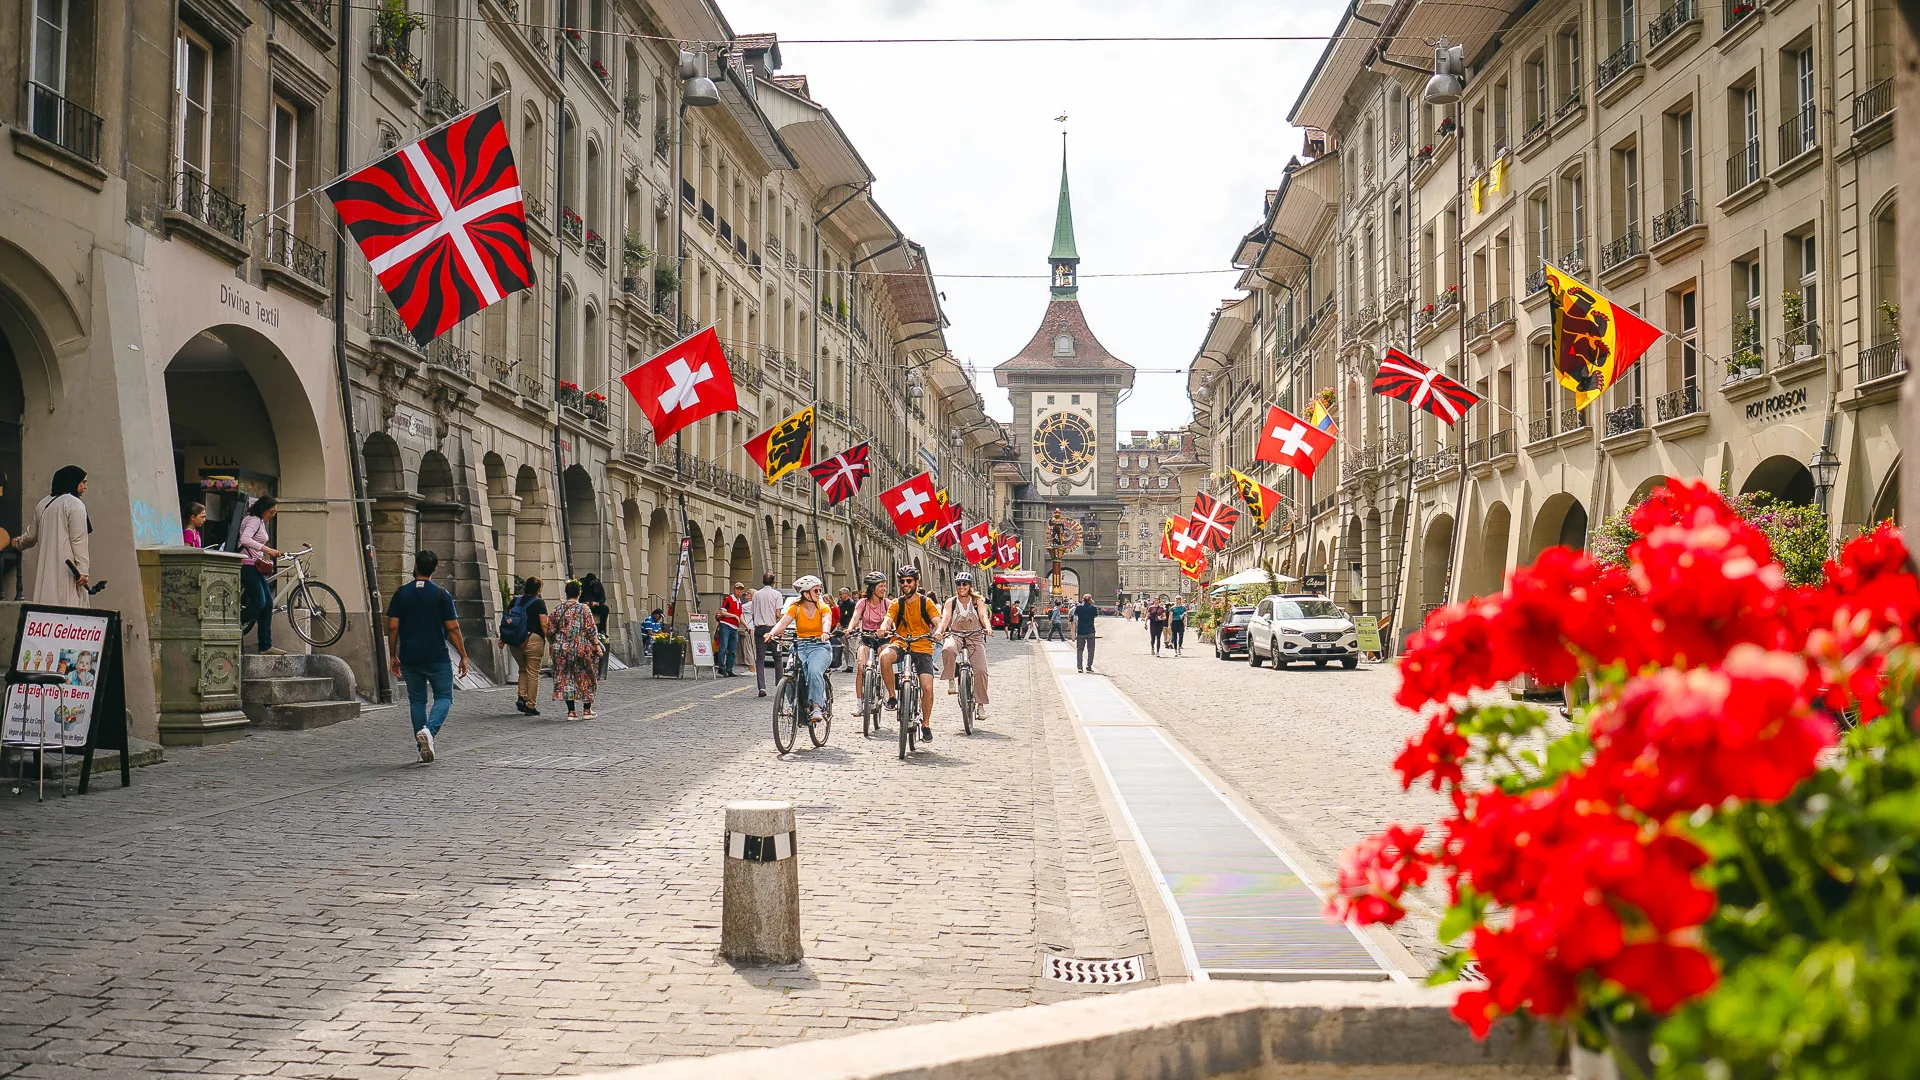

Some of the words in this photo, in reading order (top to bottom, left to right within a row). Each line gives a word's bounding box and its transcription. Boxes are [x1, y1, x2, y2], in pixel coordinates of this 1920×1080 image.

[220, 283, 250, 316] Divina
[256, 300, 280, 329] Textil
[1745, 400, 1765, 420] ROY
[1766, 386, 1807, 413] ROBSON
[27, 621, 53, 637] BACI
[53, 623, 102, 642] Gelateria
[17, 684, 60, 700] Eizigrtig
[70, 688, 90, 700] Bern
